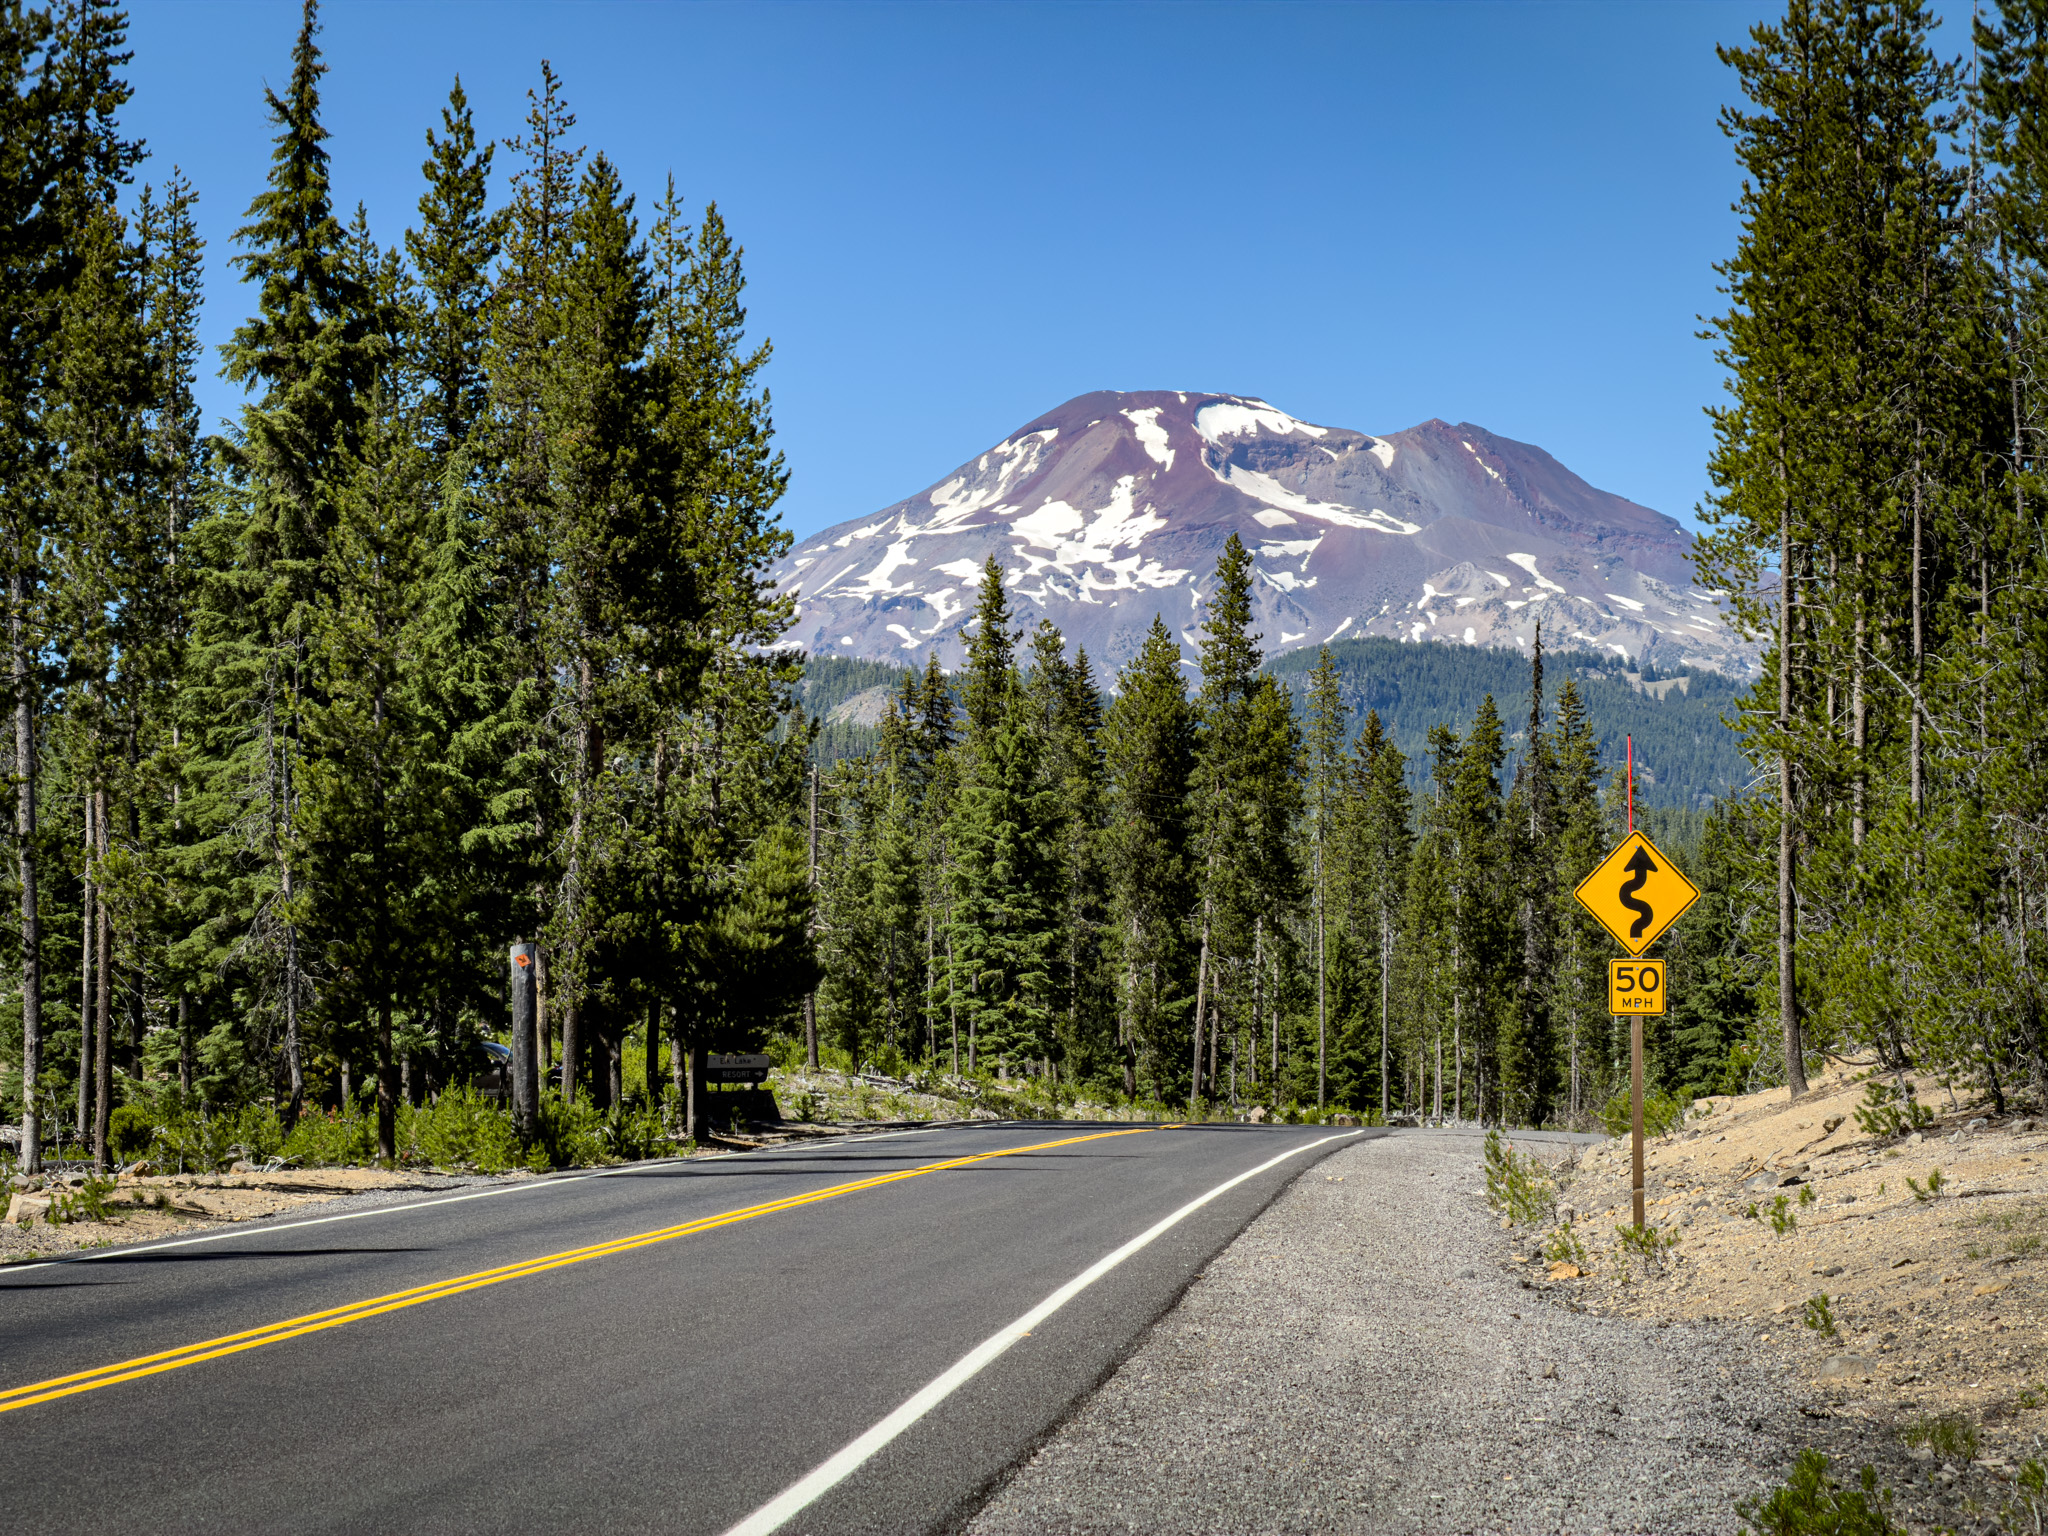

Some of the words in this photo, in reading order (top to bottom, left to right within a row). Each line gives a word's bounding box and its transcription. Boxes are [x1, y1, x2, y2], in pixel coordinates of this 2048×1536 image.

[1616, 966, 1660, 992] 50
[1622, 998, 1653, 1008] MPH
[722, 1070, 751, 1078] RESORT
